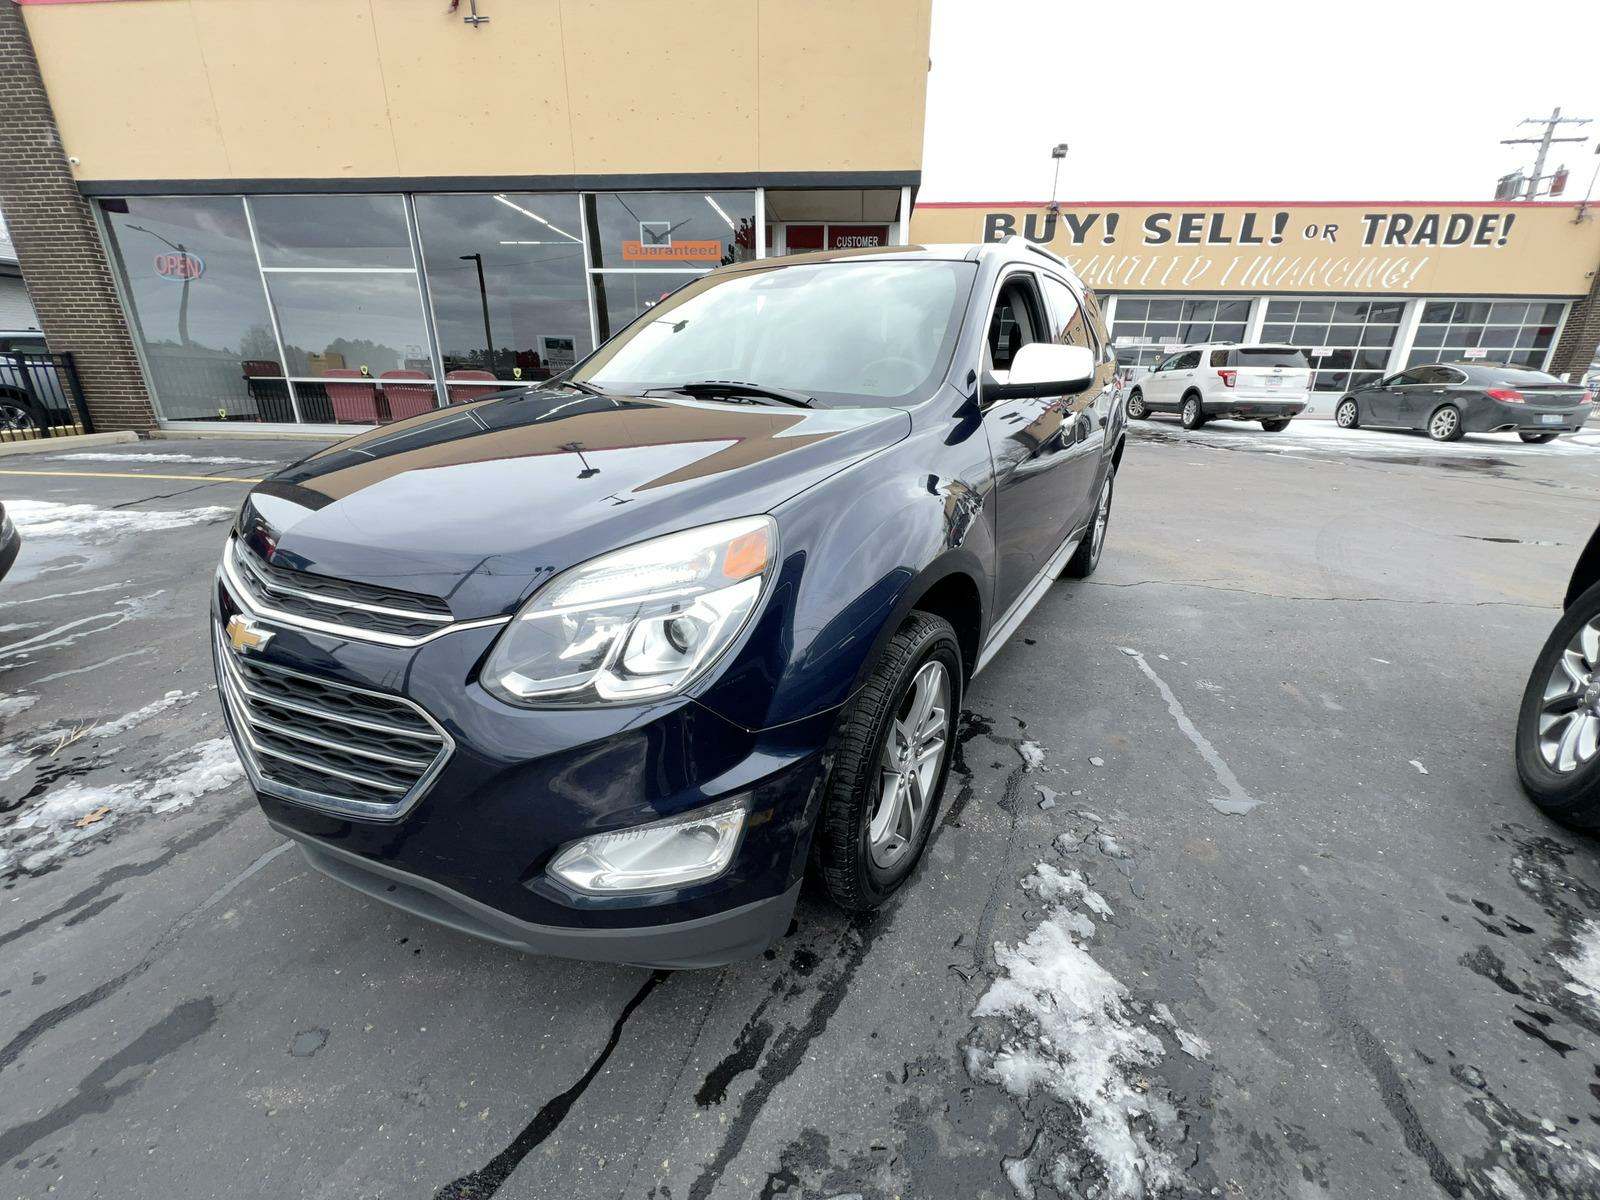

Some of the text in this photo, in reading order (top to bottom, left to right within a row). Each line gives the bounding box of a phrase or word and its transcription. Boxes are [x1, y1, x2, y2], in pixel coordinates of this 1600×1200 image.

[984, 212, 1517, 247] BUY! SELL! OR TRADE!
[626, 243, 718, 257] Guaranteed
[836, 235, 879, 247] CUSTOMER
[154, 255, 201, 279] OPEN
